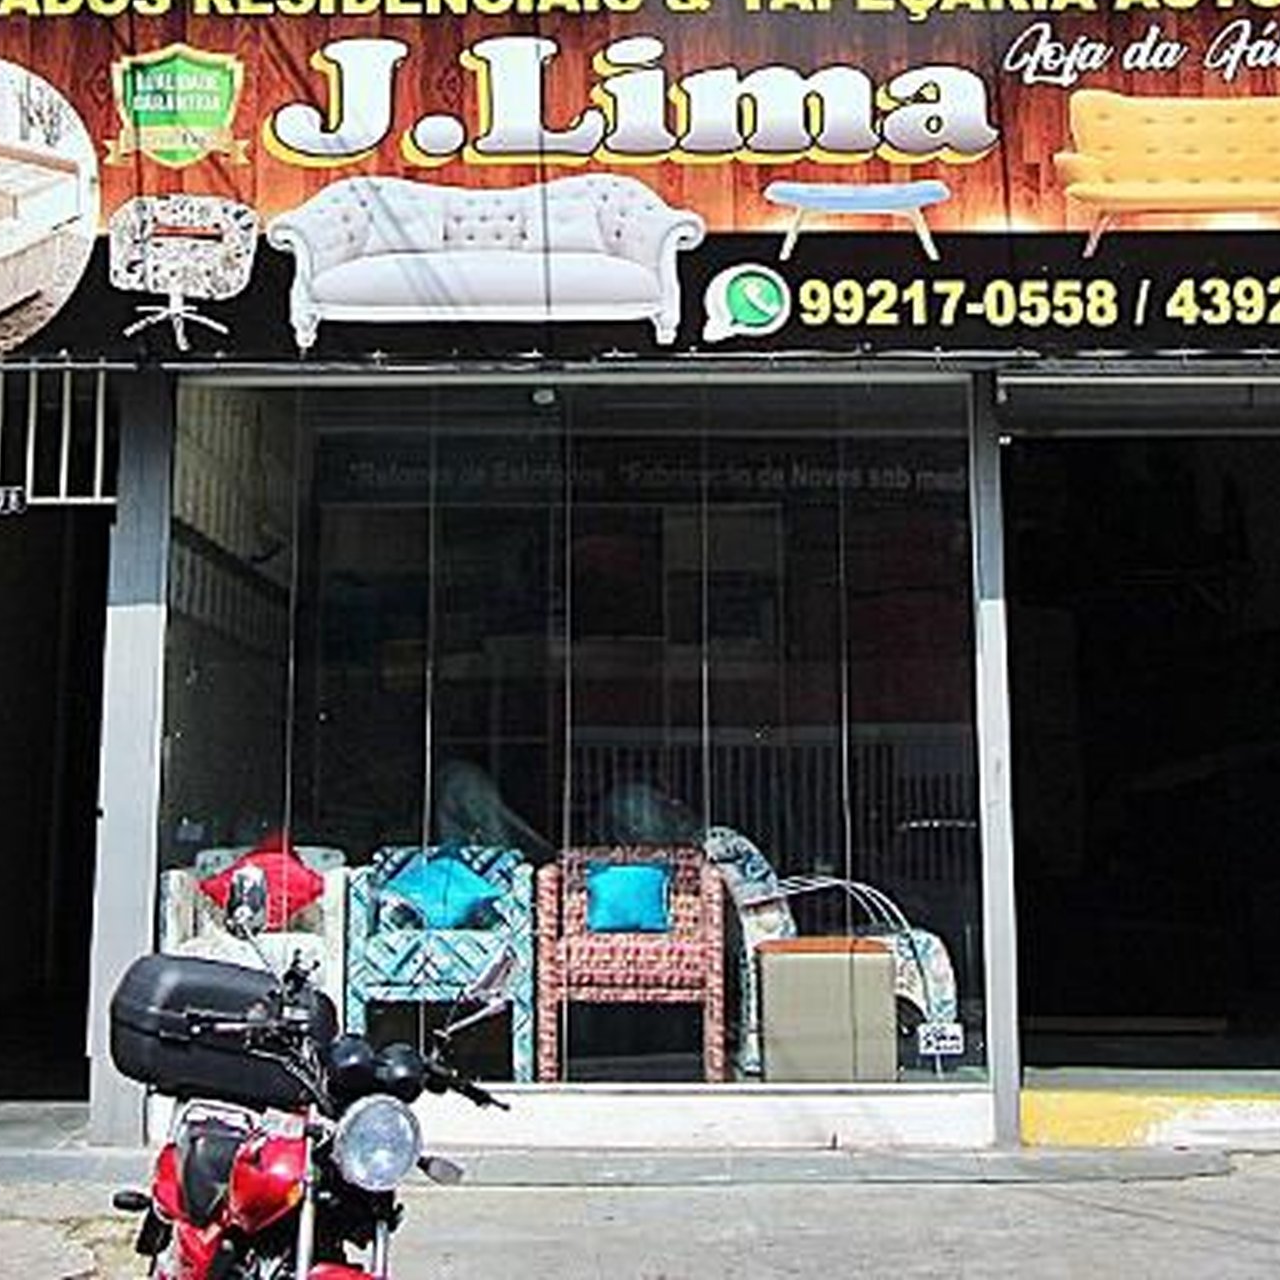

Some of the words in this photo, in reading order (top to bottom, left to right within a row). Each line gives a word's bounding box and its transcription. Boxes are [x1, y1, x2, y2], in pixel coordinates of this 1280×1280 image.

[1003, 21, 1116, 86] Loja
[1122, 24, 1189, 70] da
[263, 34, 1002, 167] J.Lima
[798, 276, 1118, 327] 99217-0558
[1133, 279, 1150, 327] /
